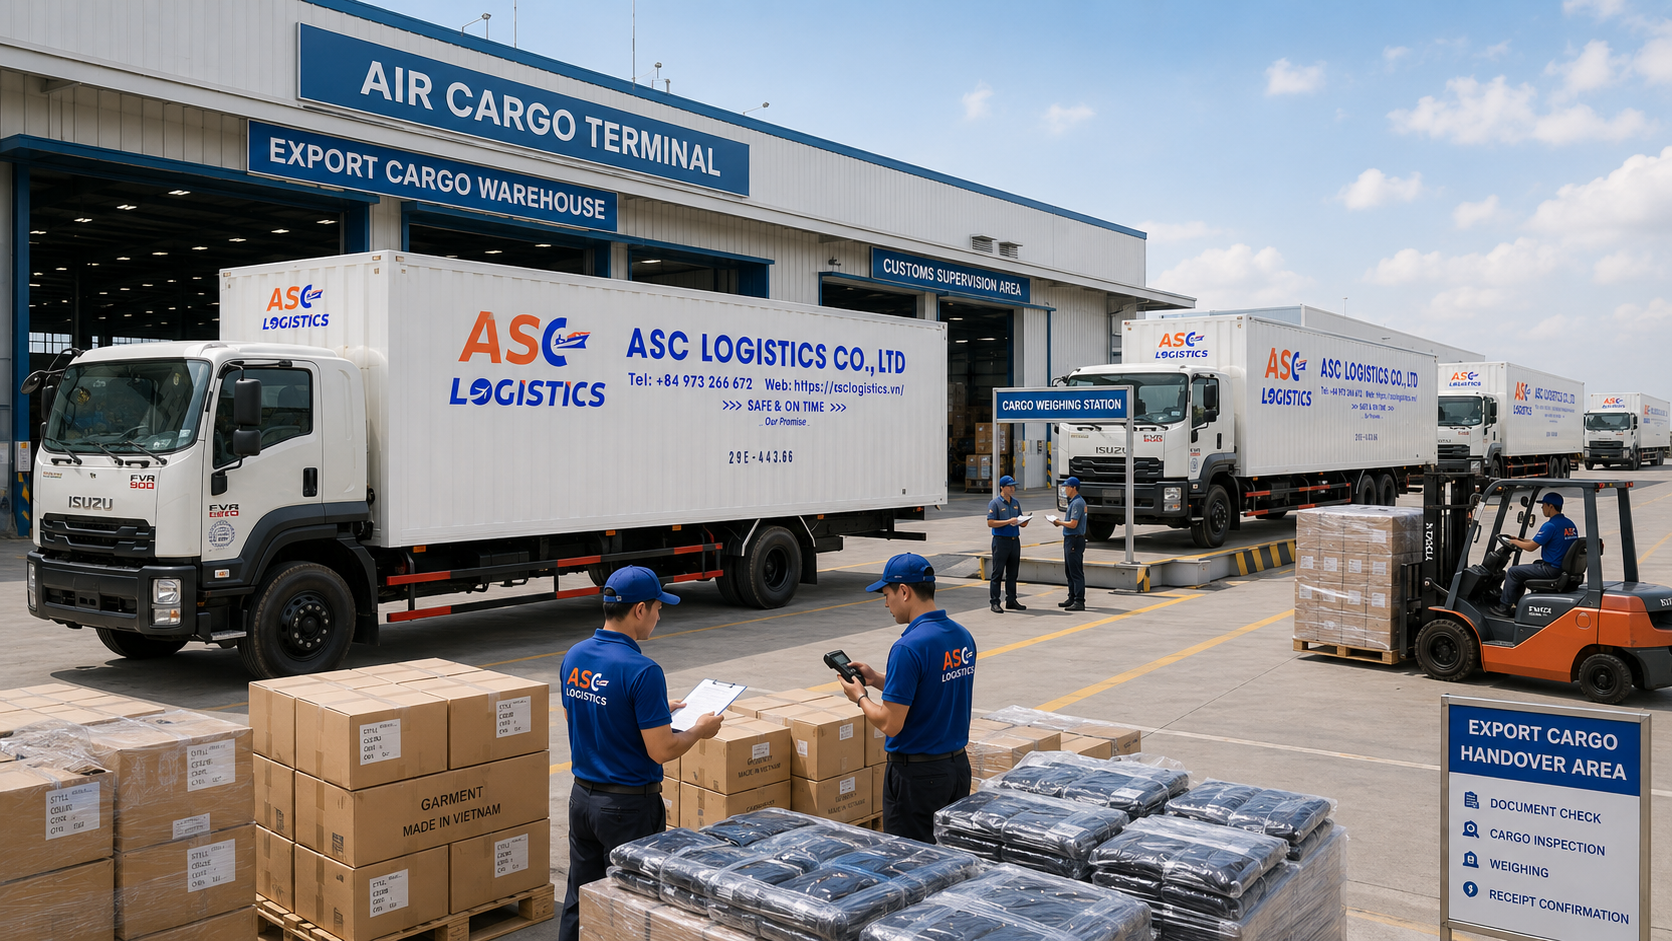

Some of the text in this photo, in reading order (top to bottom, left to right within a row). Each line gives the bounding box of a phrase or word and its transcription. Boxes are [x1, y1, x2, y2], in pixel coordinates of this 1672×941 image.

[360, 60, 720, 177] AIR CARGO TERMINAL
[269, 136, 605, 220] EXPORT CARGO WAREHOUSE
[883, 258, 1021, 296] CUSTOMS SUPERVISION AREA
[266, 284, 314, 311] ASC
[263, 313, 329, 330] LOGISTICS
[458, 311, 569, 367] ASC
[626, 327, 689, 361] ASC
[701, 333, 827, 369] LOGISTICS
[1158, 331, 1196, 348] ASC
[1155, 350, 1208, 359] LOGISTICS
[1265, 347, 1300, 382] ASC
[628, 372, 652, 387] Tel:
[656, 374, 679, 387] +84
[683, 375, 705, 388] 973
[708, 375, 729, 389] 266
[732, 376, 753, 390] 672
[765, 378, 792, 391] Web:
[1320, 358, 1342, 379] ASC
[1344, 361, 1388, 385] LOGISTICS
[449, 377, 606, 408] LOGISTICS
[1002, 398, 1122, 412] CARGO WEIGHING STATION
[1261, 387, 1312, 407] LOGISTICS
[747, 400, 825, 412] SAFE & ON TIME
[780, 417, 807, 426] Promise
[130, 474, 155, 482] FVR
[130, 481, 155, 489] 900
[68, 496, 114, 511] ISUZU
[943, 646, 969, 671] ASC
[567, 667, 603, 692] ASC
[566, 688, 607, 706] LOGISTICS
[1468, 719, 1618, 750] EXPORT CARGO
[1460, 745, 1627, 781] HANDOVER AREA
[421, 785, 484, 811] GARMENT
[1490, 798, 1602, 824] DOCUMENT CHECK
[403, 803, 501, 837] MADE IN VIETNAM
[1490, 828, 1606, 856] CARGO INSPECTION
[1489, 858, 1549, 878] WEIGHING
[1489, 889, 1629, 925] RECEIPT CONFIRMATION
